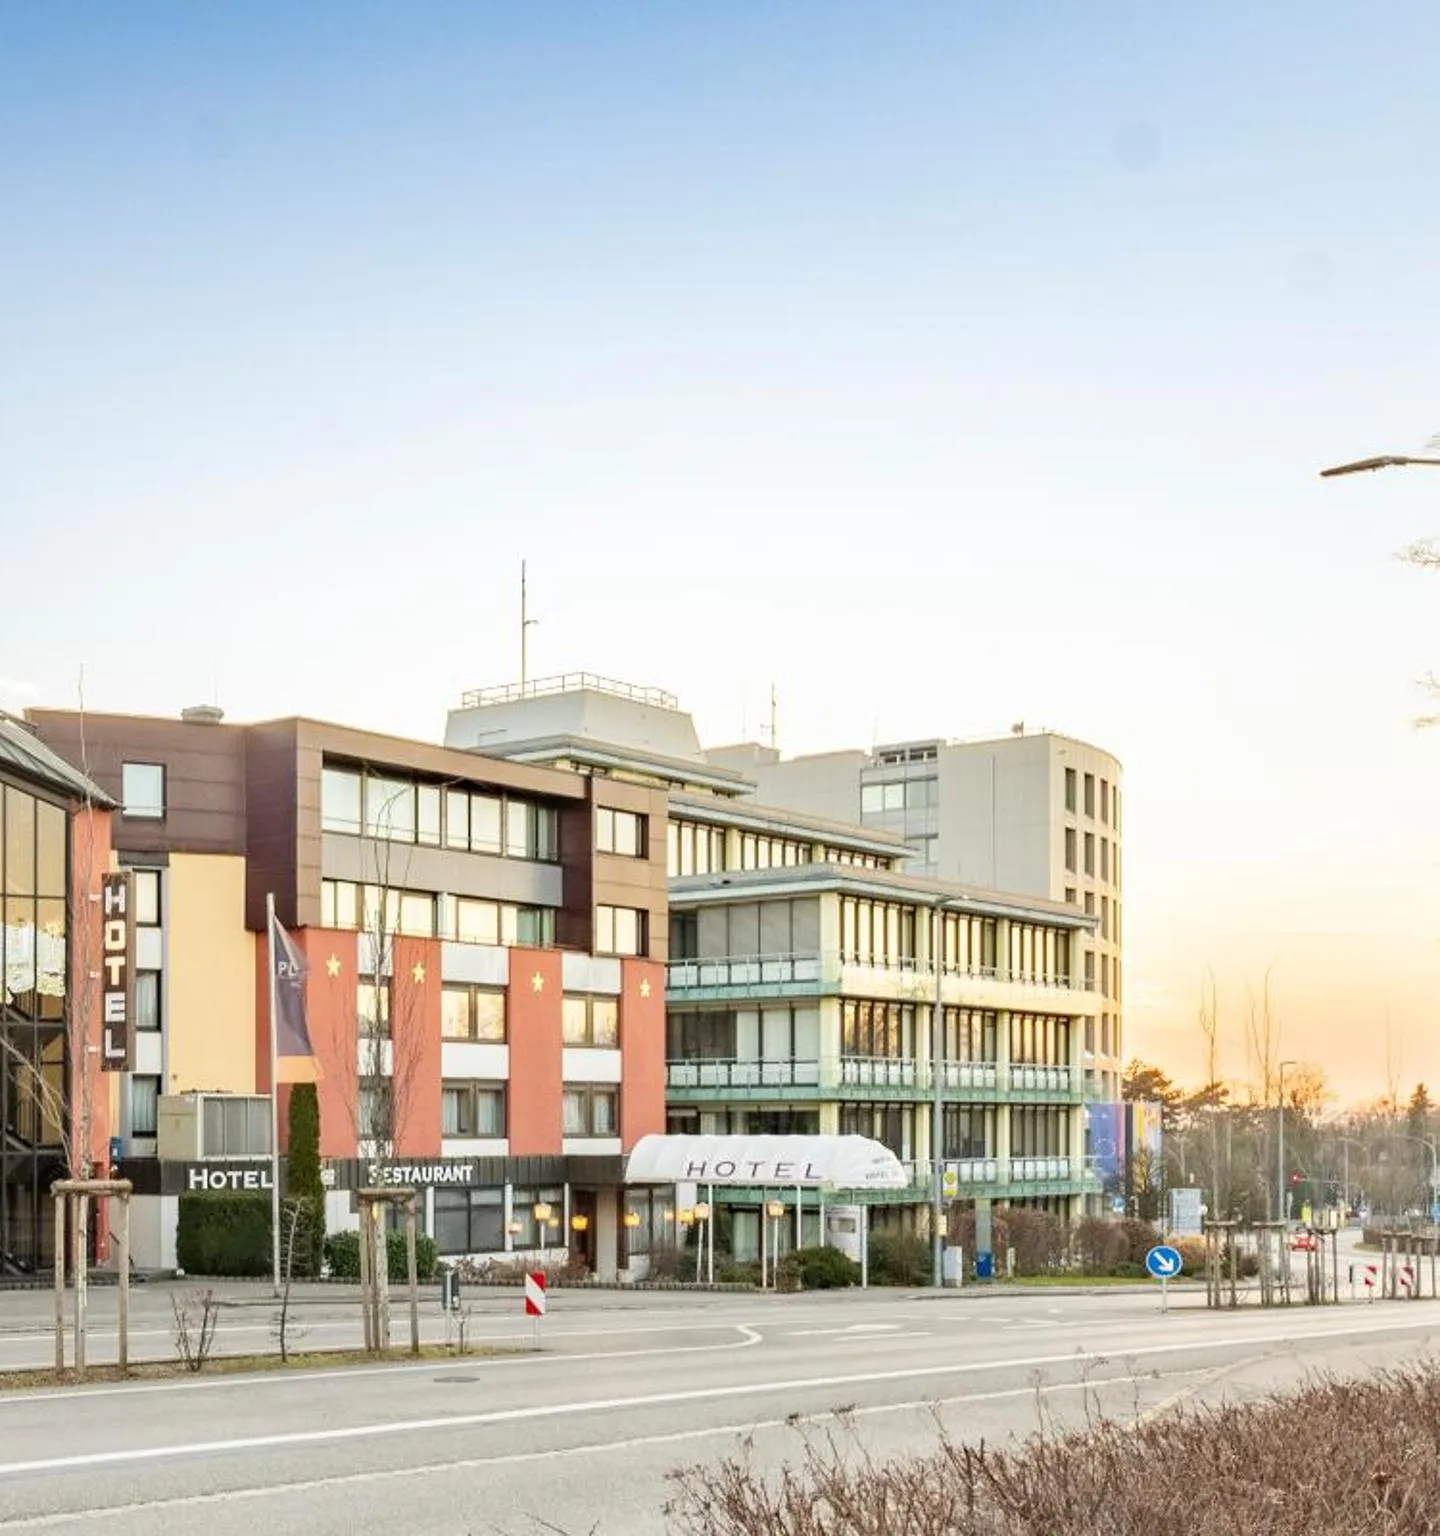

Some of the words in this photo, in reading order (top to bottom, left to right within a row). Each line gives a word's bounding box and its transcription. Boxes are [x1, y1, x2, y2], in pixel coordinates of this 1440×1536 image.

[105, 885, 126, 1058] HOTEL
[189, 1168, 273, 1190] HOTEL
[686, 1160, 824, 1179] HOTEL
